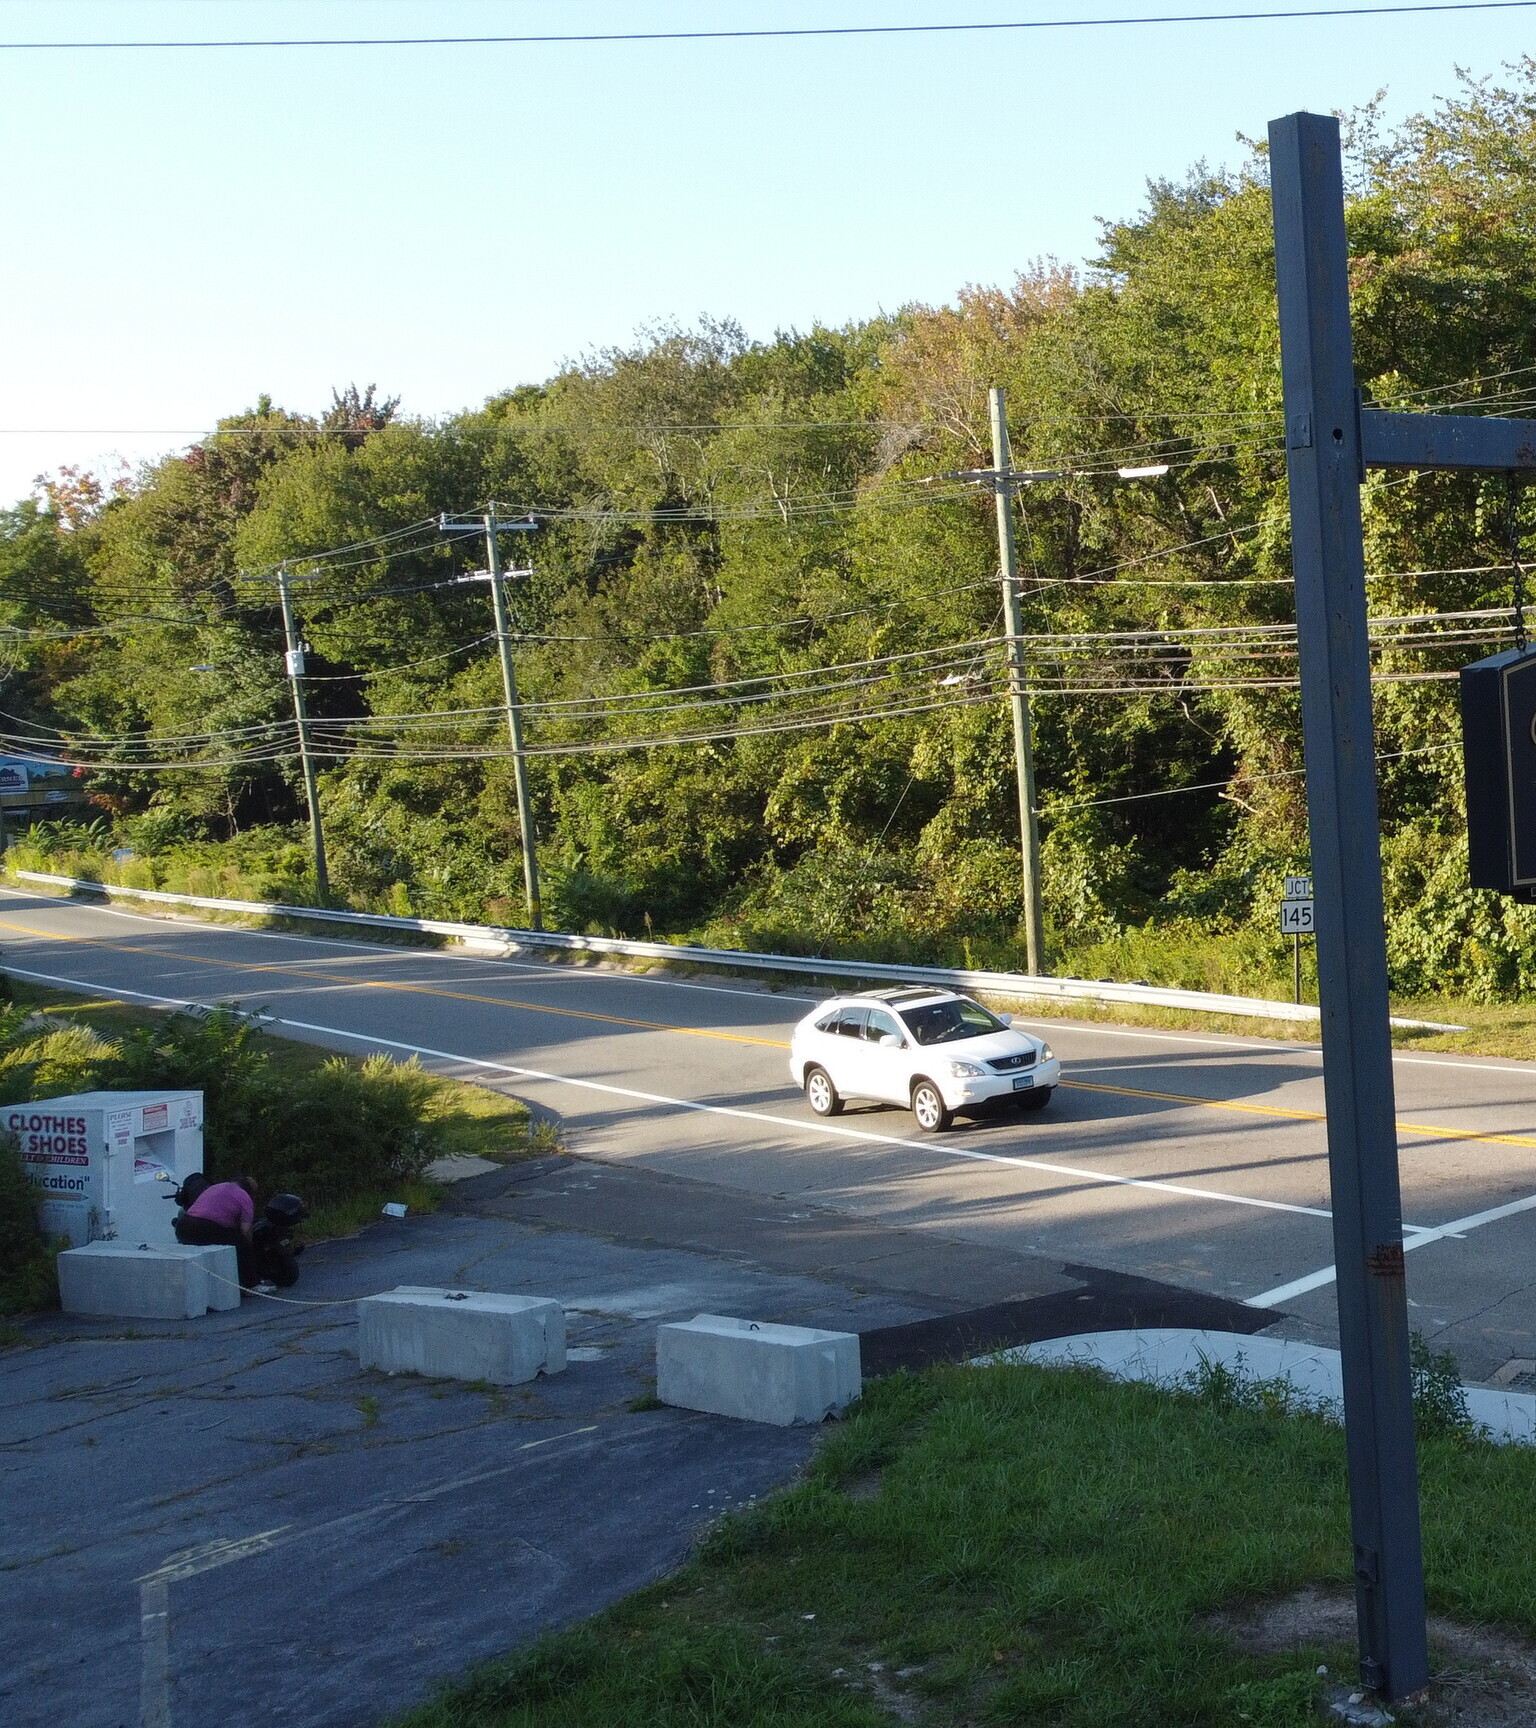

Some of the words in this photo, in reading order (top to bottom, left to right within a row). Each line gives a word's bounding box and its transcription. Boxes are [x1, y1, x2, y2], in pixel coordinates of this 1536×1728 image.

[1288, 881, 1307, 895] JCT
[1283, 907, 1312, 926] 145
[8, 1113, 86, 1136] CLOTHES
[28, 1134, 88, 1156] SHOES
